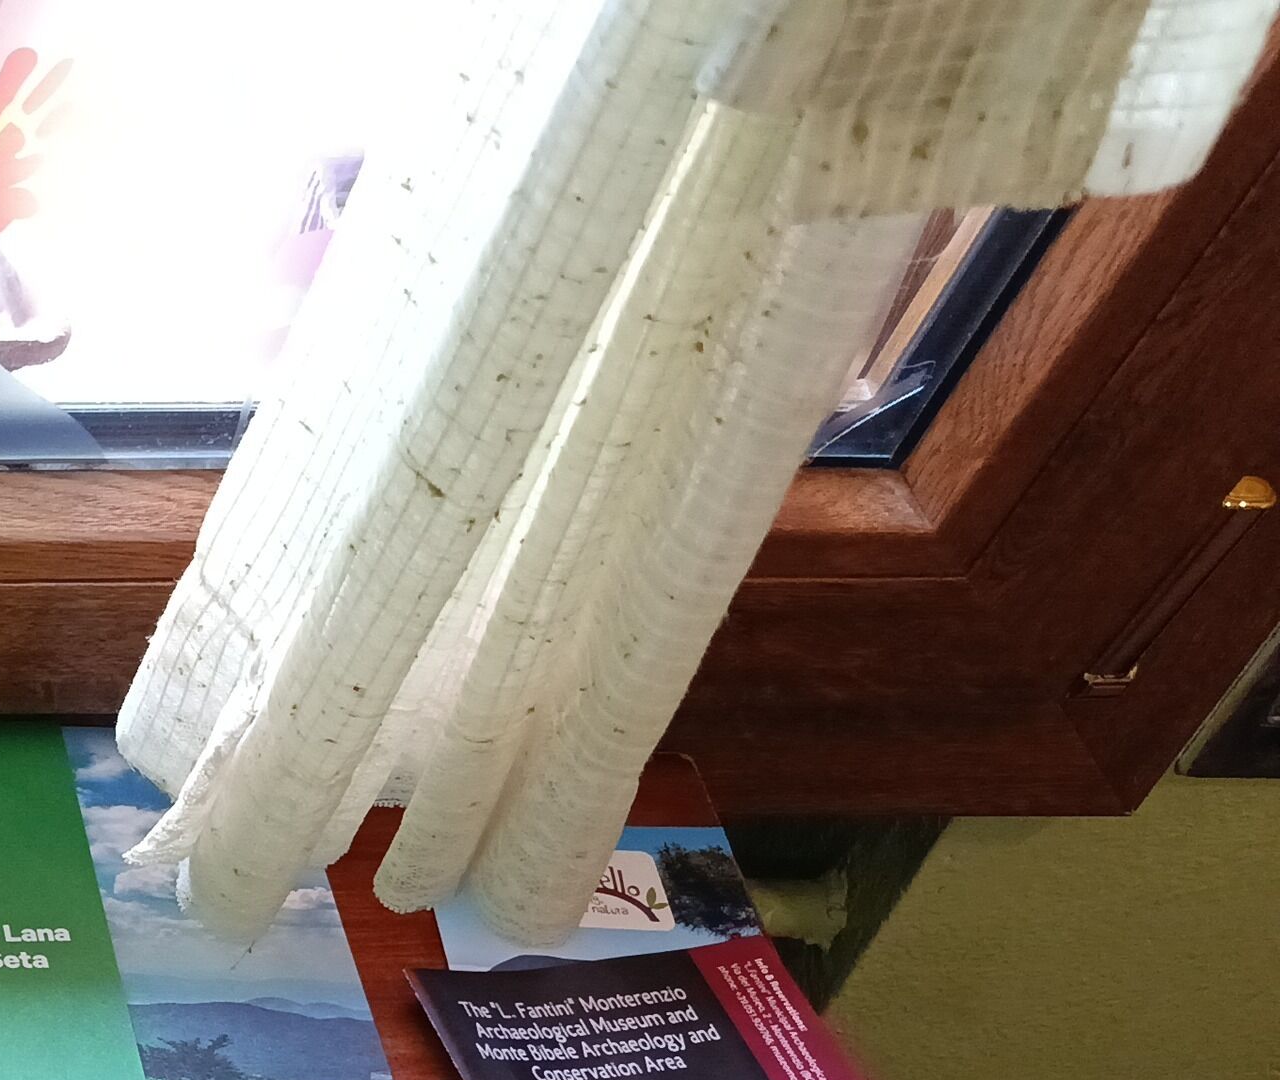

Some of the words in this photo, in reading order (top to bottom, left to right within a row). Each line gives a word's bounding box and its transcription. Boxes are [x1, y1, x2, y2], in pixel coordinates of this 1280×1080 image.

[2, 923, 72, 943] Lana
[458, 1000, 492, 1019] The
[578, 985, 687, 1013] Monterenzio
[475, 1018, 590, 1044] Archaeological
[589, 1012, 666, 1036] Museum
[668, 1004, 700, 1023] and
[475, 1042, 530, 1062] Monte
[529, 1041, 579, 1062] Bibele
[582, 1032, 686, 1058] Archaeology
[688, 1023, 722, 1043] and
[643, 1053, 688, 1074] Area
